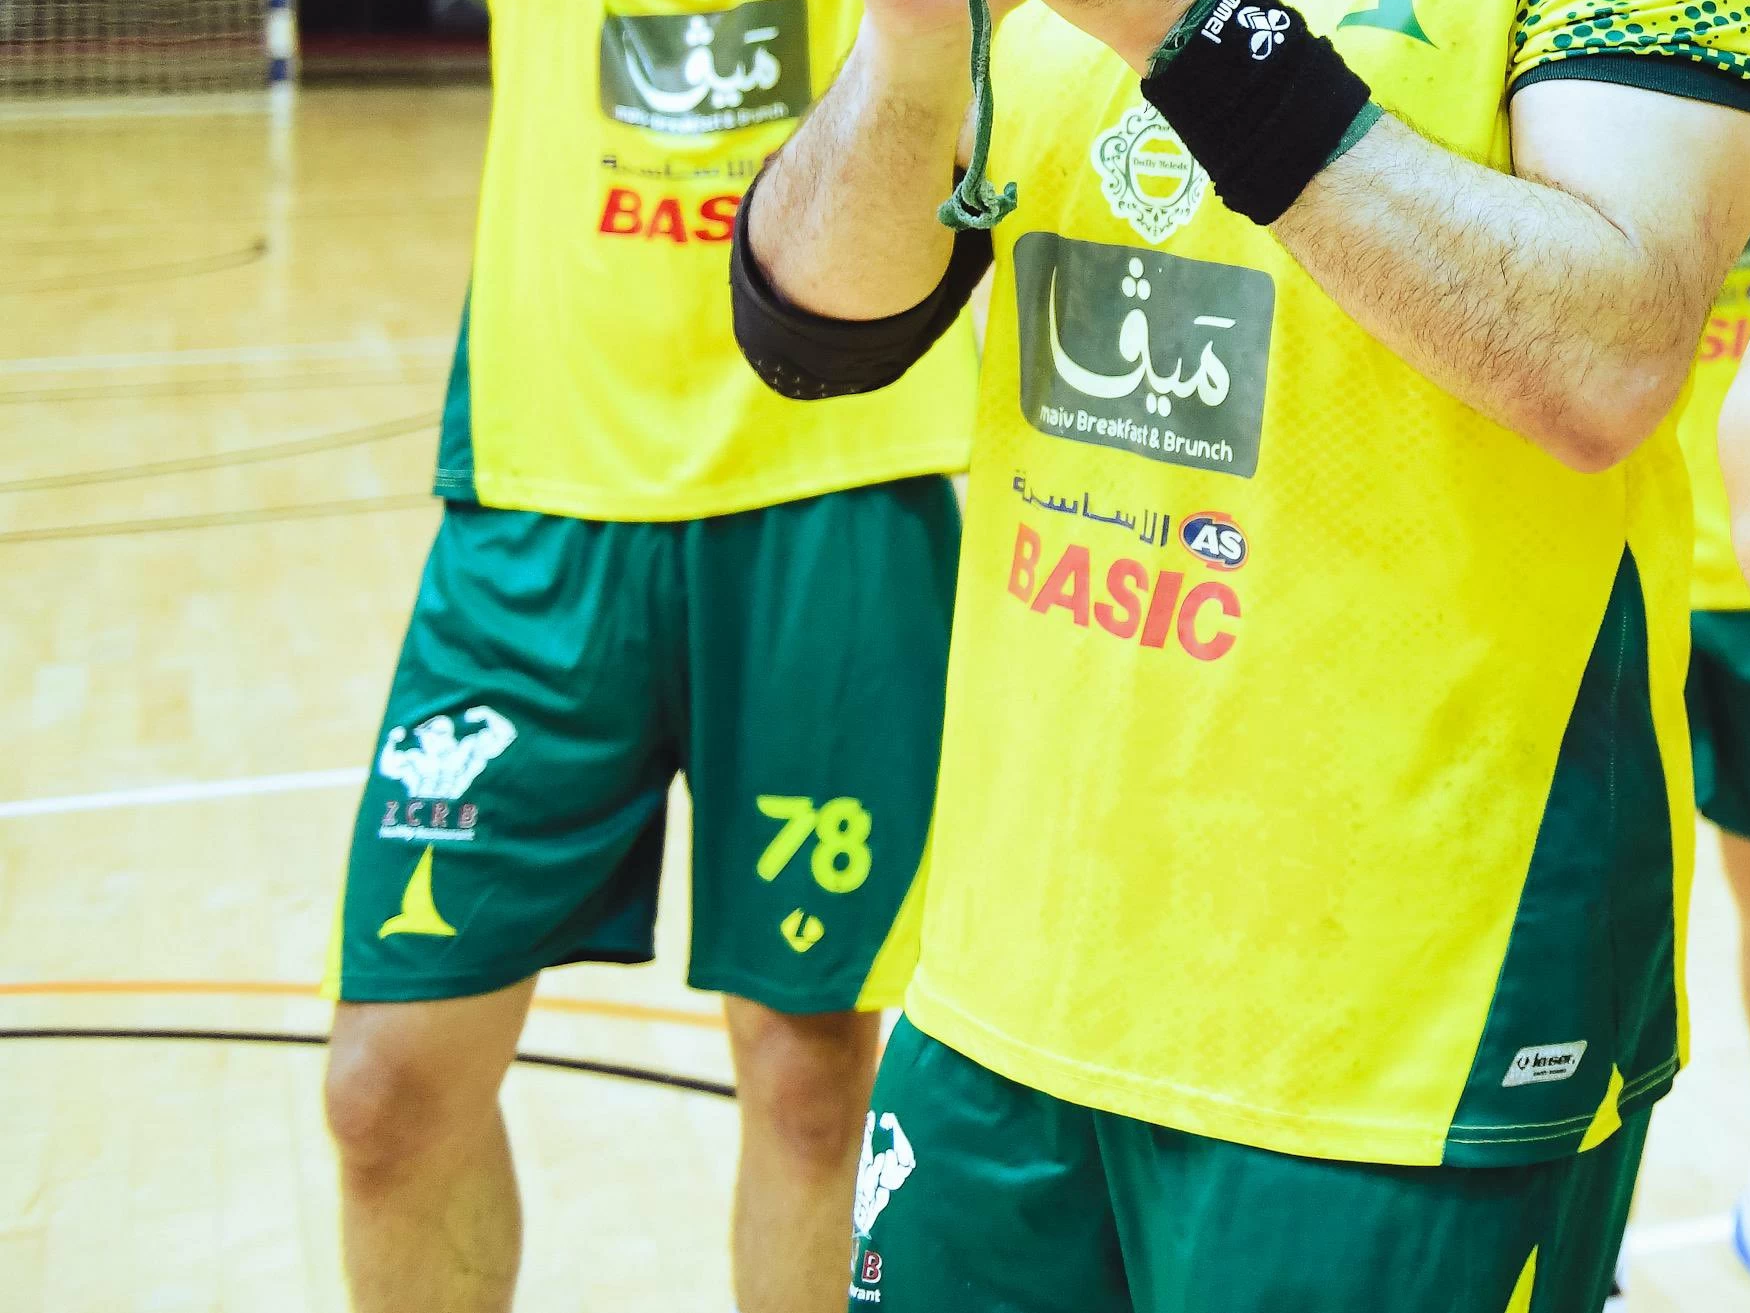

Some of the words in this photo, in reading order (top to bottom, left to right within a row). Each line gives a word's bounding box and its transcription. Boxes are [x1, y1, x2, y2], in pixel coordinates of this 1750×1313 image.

[1040, 403, 1074, 430] maiv
[1076, 409, 1148, 447] Breakfast
[1148, 426, 1160, 448] &
[1163, 430, 1234, 463] Brunch
[1191, 524, 1243, 560] AS
[1007, 522, 1242, 661] BASIC
[756, 794, 873, 894] 78
